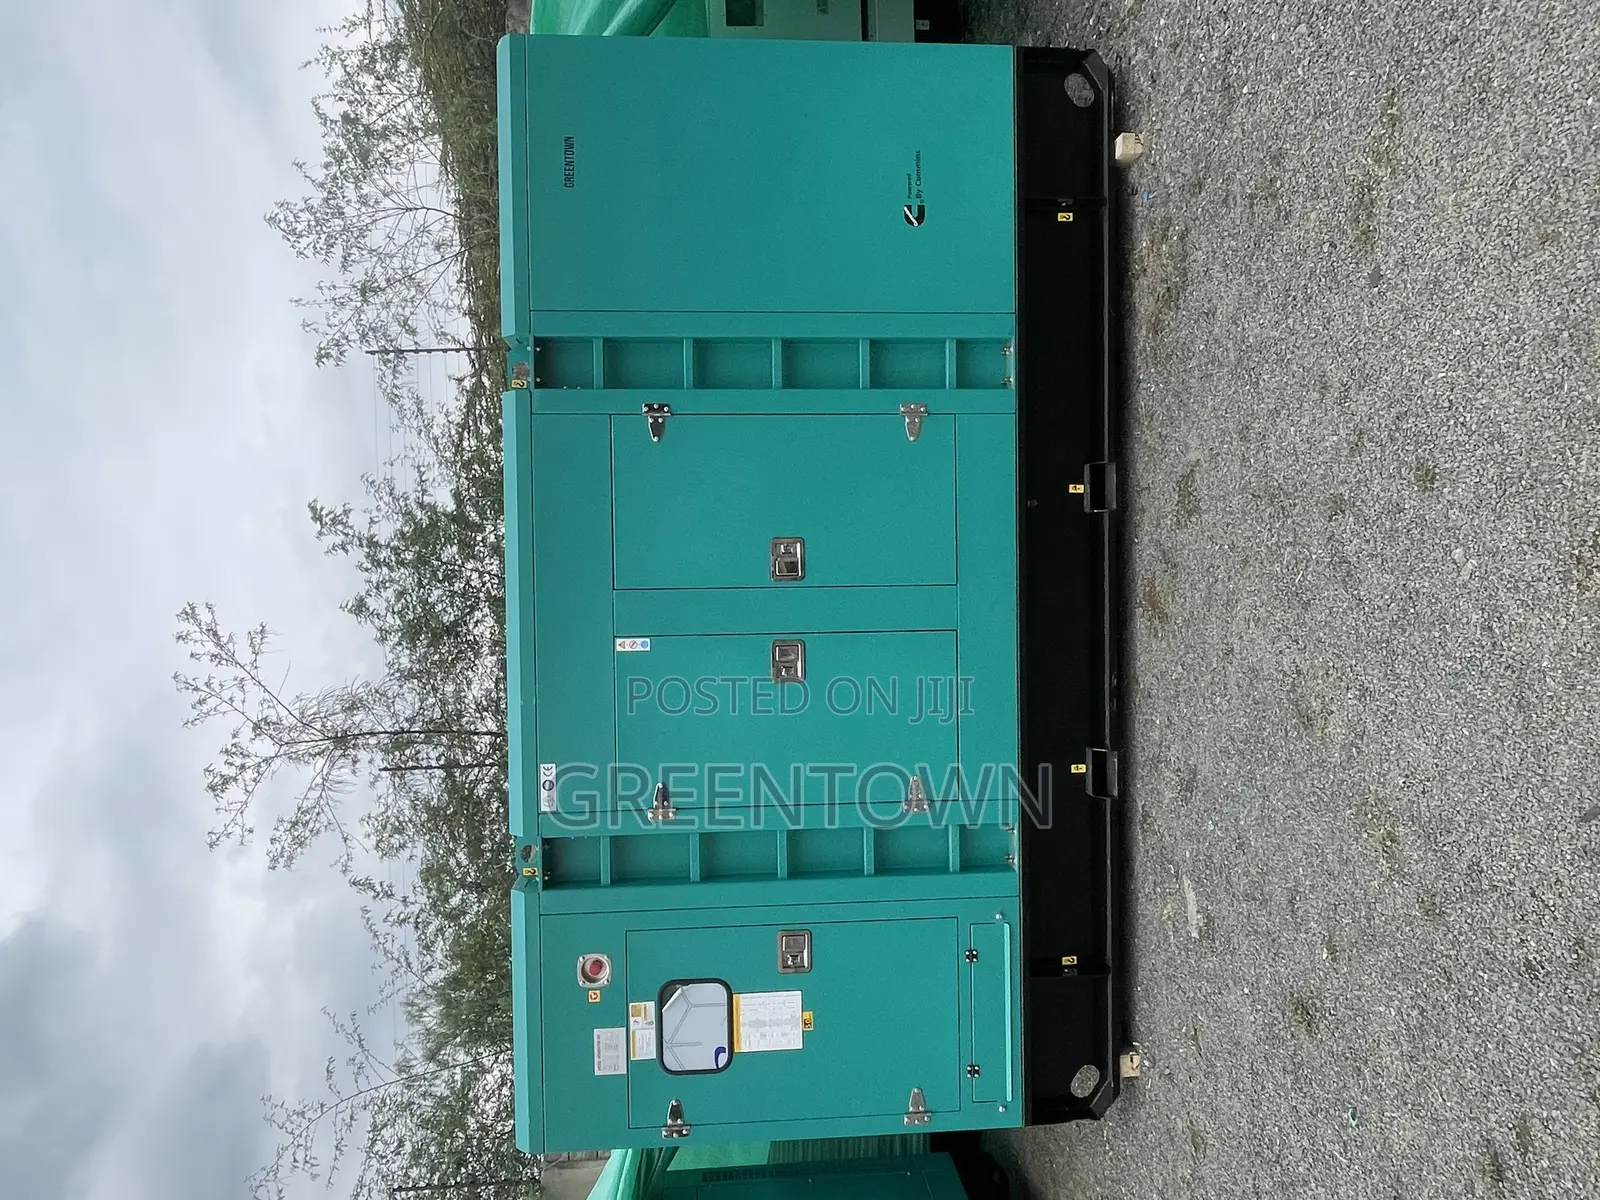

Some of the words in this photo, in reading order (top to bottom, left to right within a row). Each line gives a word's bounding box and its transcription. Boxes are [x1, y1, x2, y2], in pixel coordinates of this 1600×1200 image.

[563, 136, 575, 188] GREENTOWN
[914, 150, 922, 186] Cummins
[915, 189, 923, 199] By
